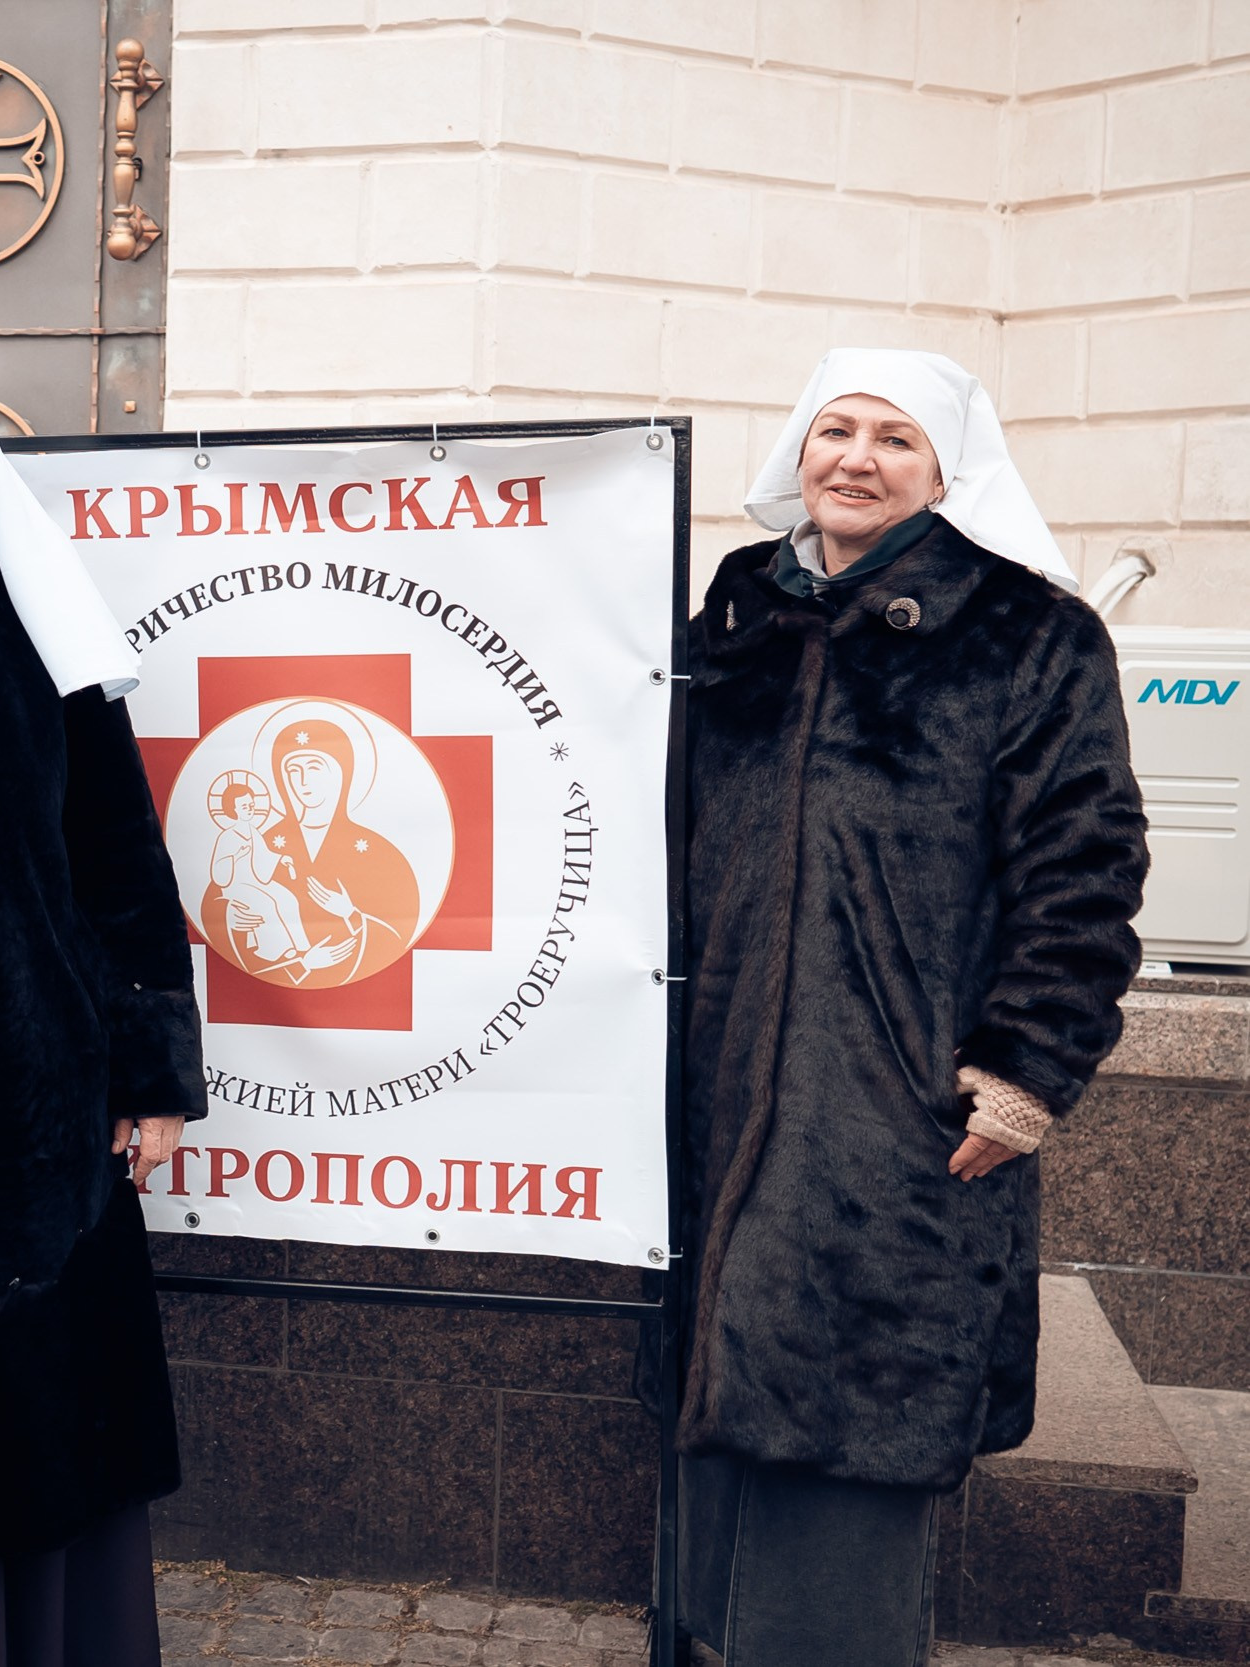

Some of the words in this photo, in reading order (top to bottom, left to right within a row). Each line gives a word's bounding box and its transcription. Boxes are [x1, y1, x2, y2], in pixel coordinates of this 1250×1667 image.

[66, 475, 548, 540] КРЫМСКАЯ
[321, 562, 563, 730] МИЛОСЕРДИЯ
[1137, 678, 1241, 706] MDV
[326, 1047, 477, 1118] МАТЕРИ
[479, 780, 599, 1057] «ТРОЕРУЧИЦА»
